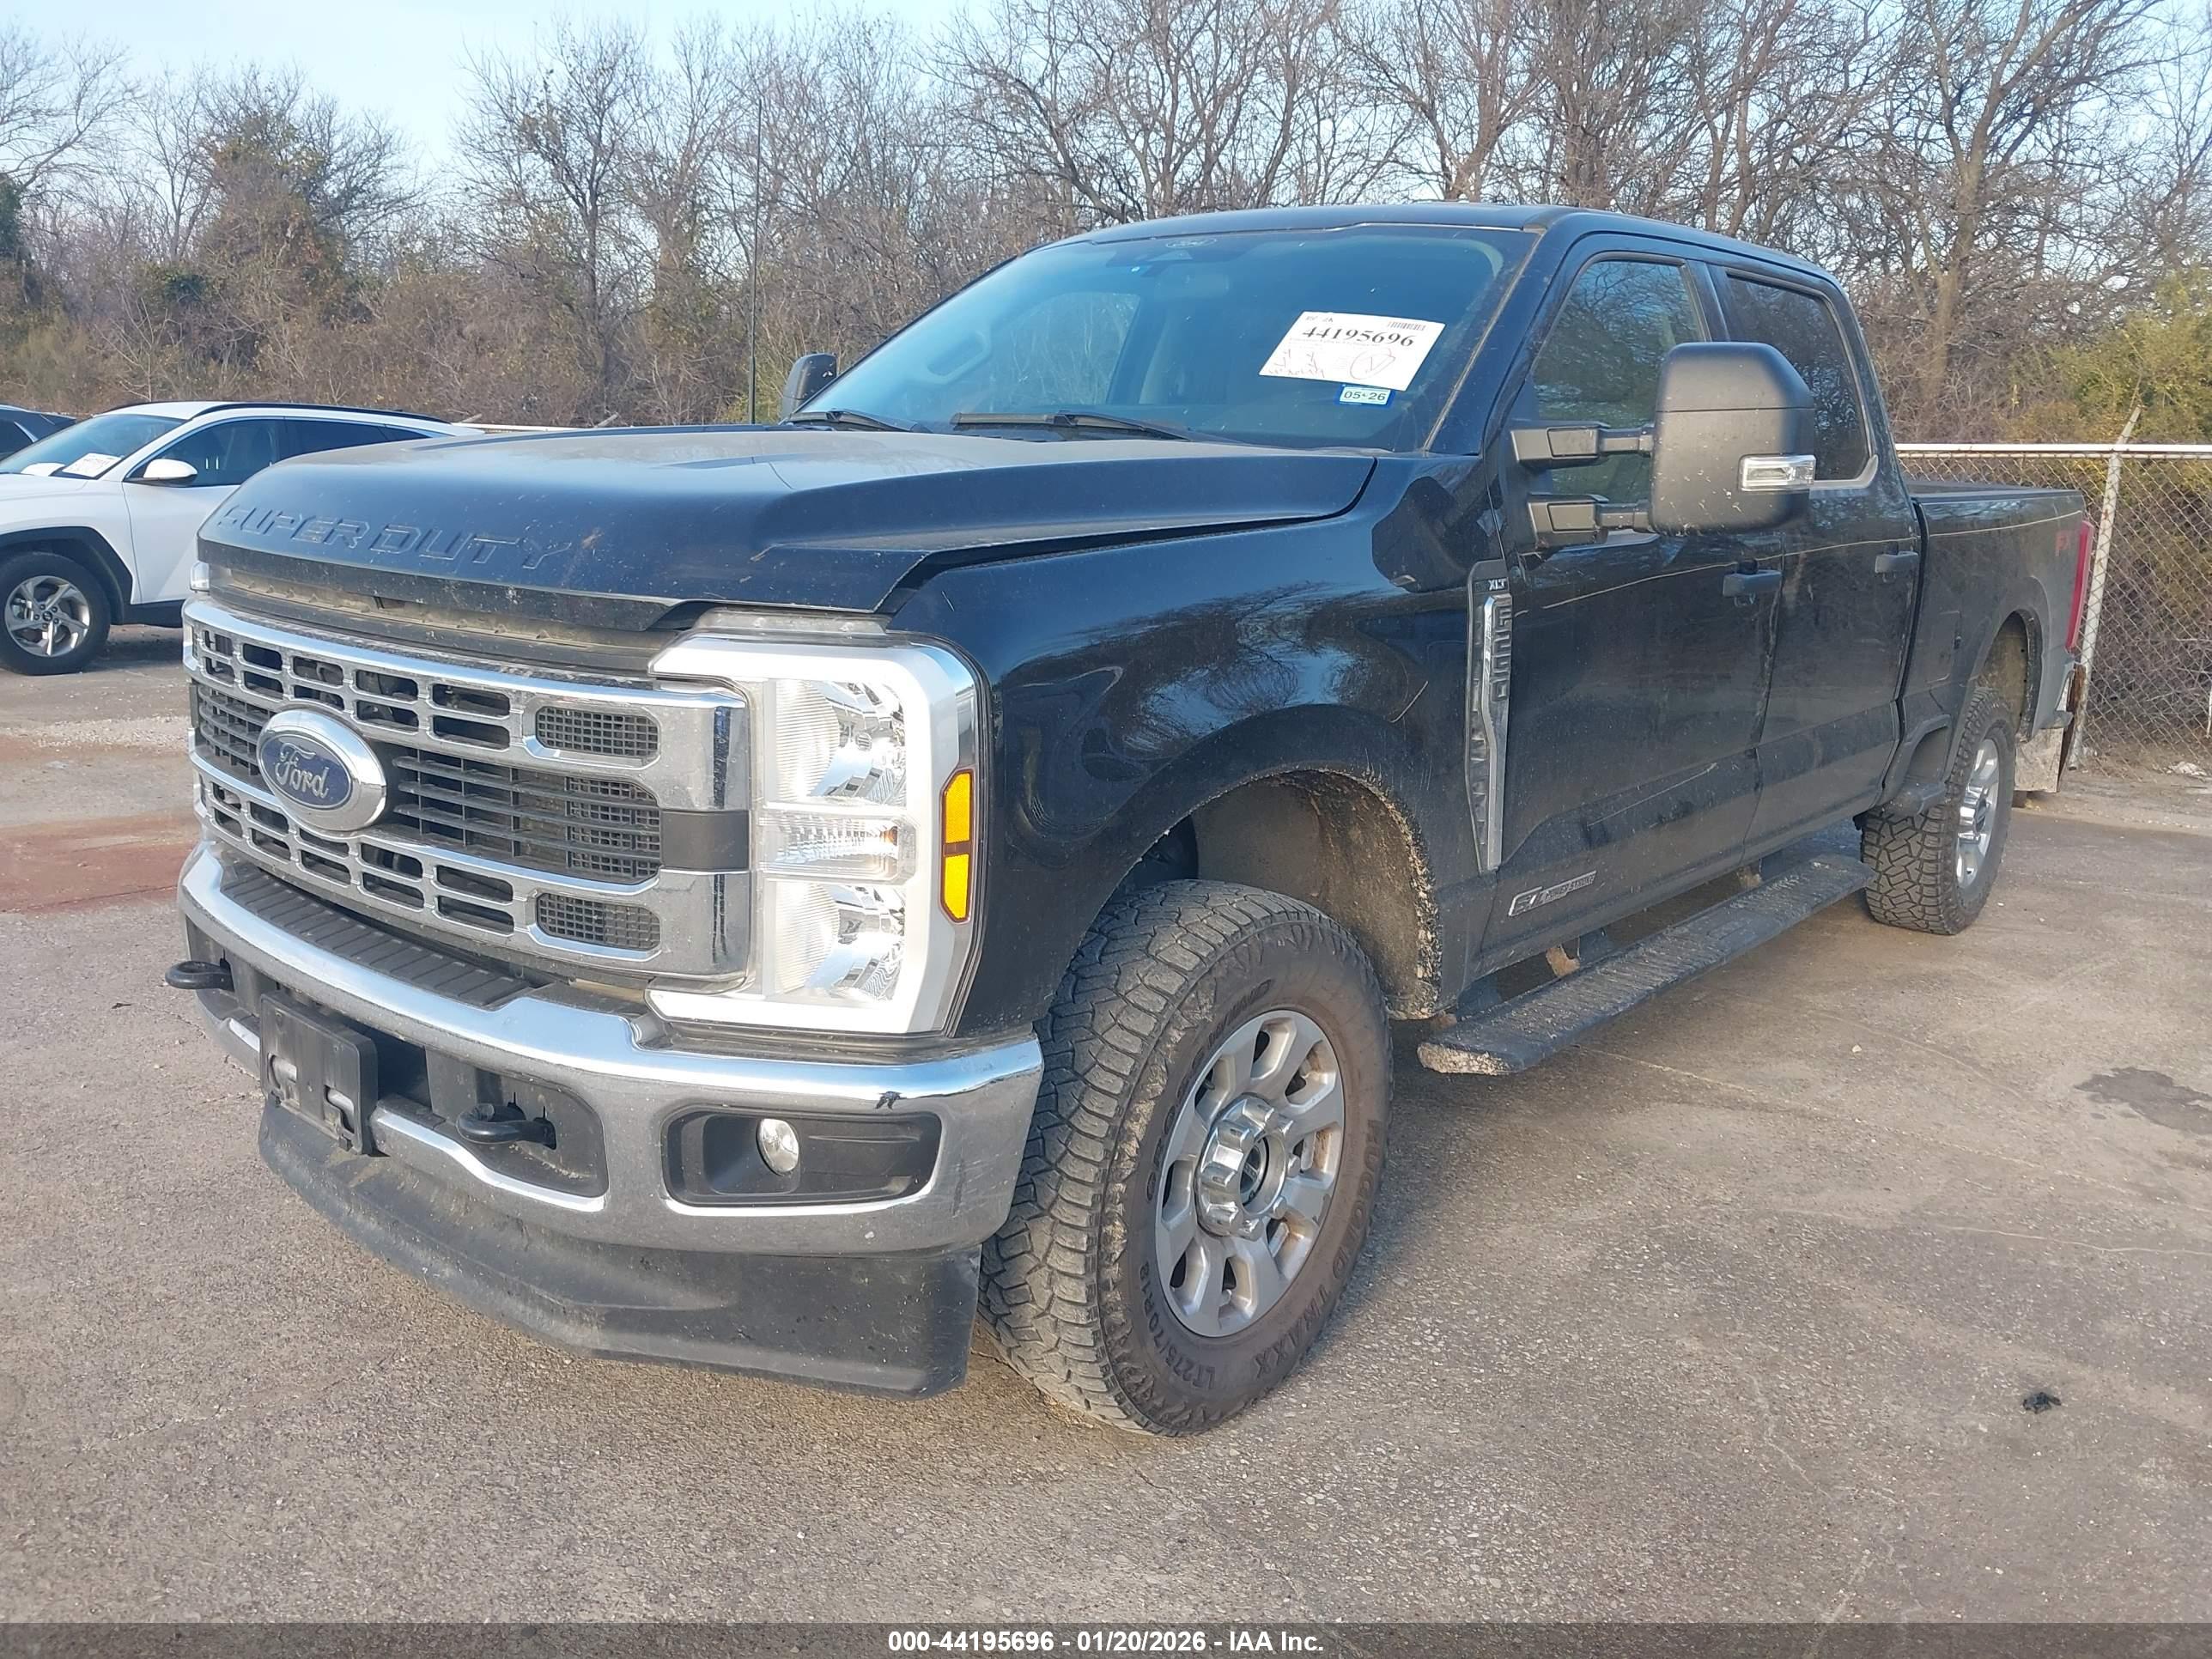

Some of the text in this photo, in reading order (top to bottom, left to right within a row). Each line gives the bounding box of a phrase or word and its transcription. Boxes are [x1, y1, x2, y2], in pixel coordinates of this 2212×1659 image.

[1302, 326, 1416, 347] 44195696
[217, 504, 573, 570] SUPER DUTY
[1487, 578, 1507, 592] XLT
[274, 742, 331, 799] Ford
